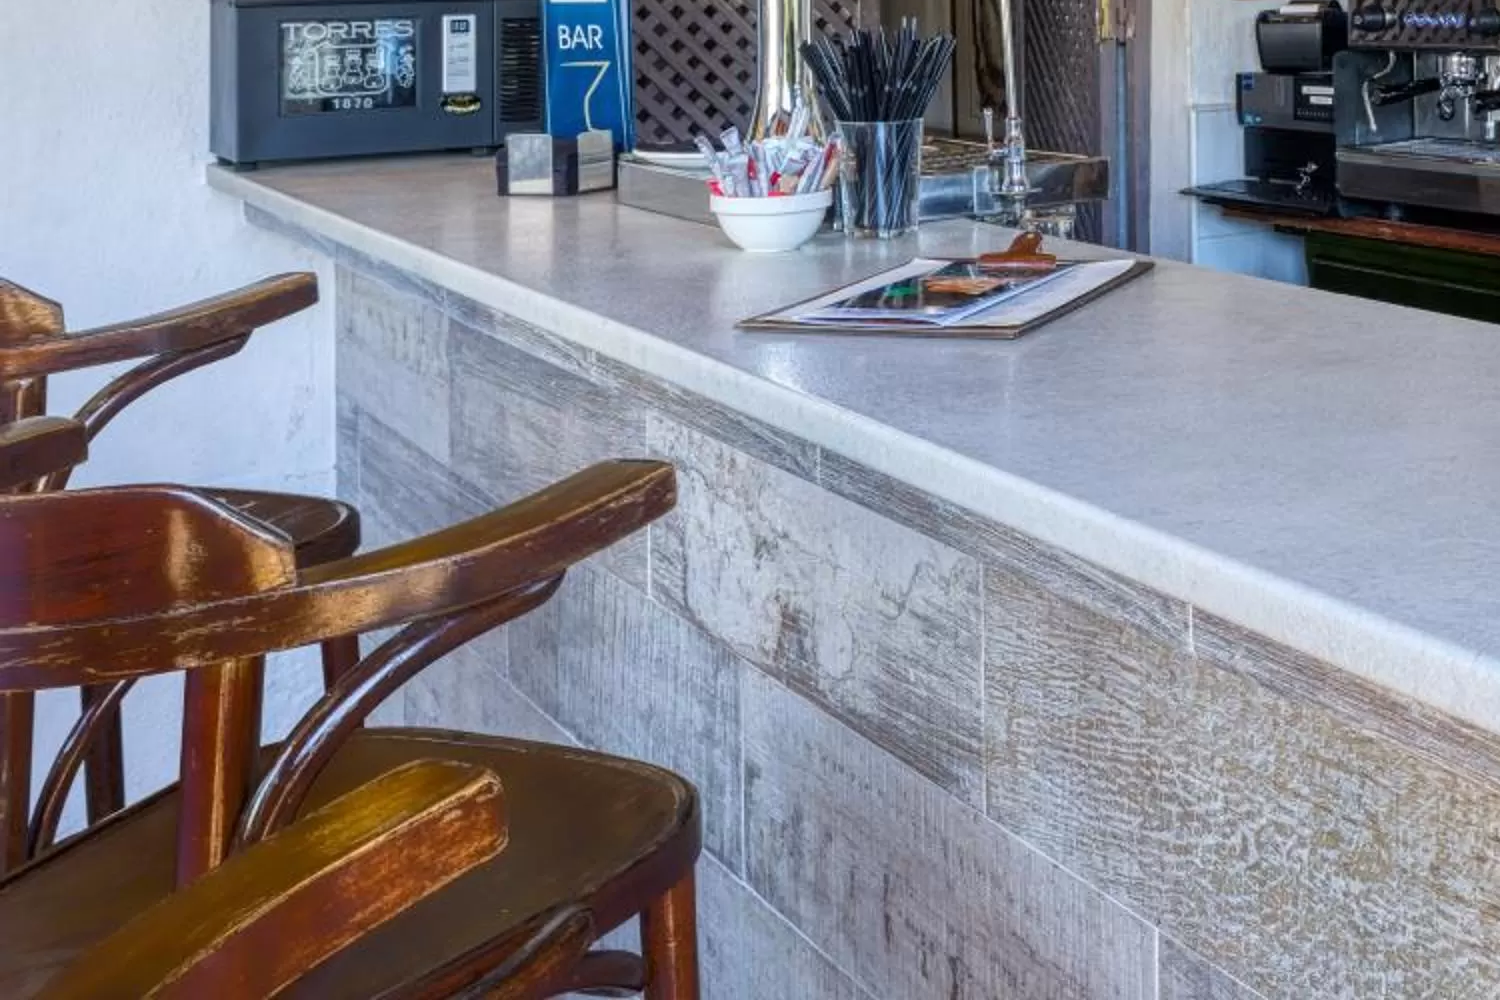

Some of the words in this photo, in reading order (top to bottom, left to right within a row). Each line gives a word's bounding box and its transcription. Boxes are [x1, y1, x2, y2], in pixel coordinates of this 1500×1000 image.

[281, 20, 414, 41] TORRES
[557, 24, 604, 50] BAR
[332, 97, 373, 109] 1870
